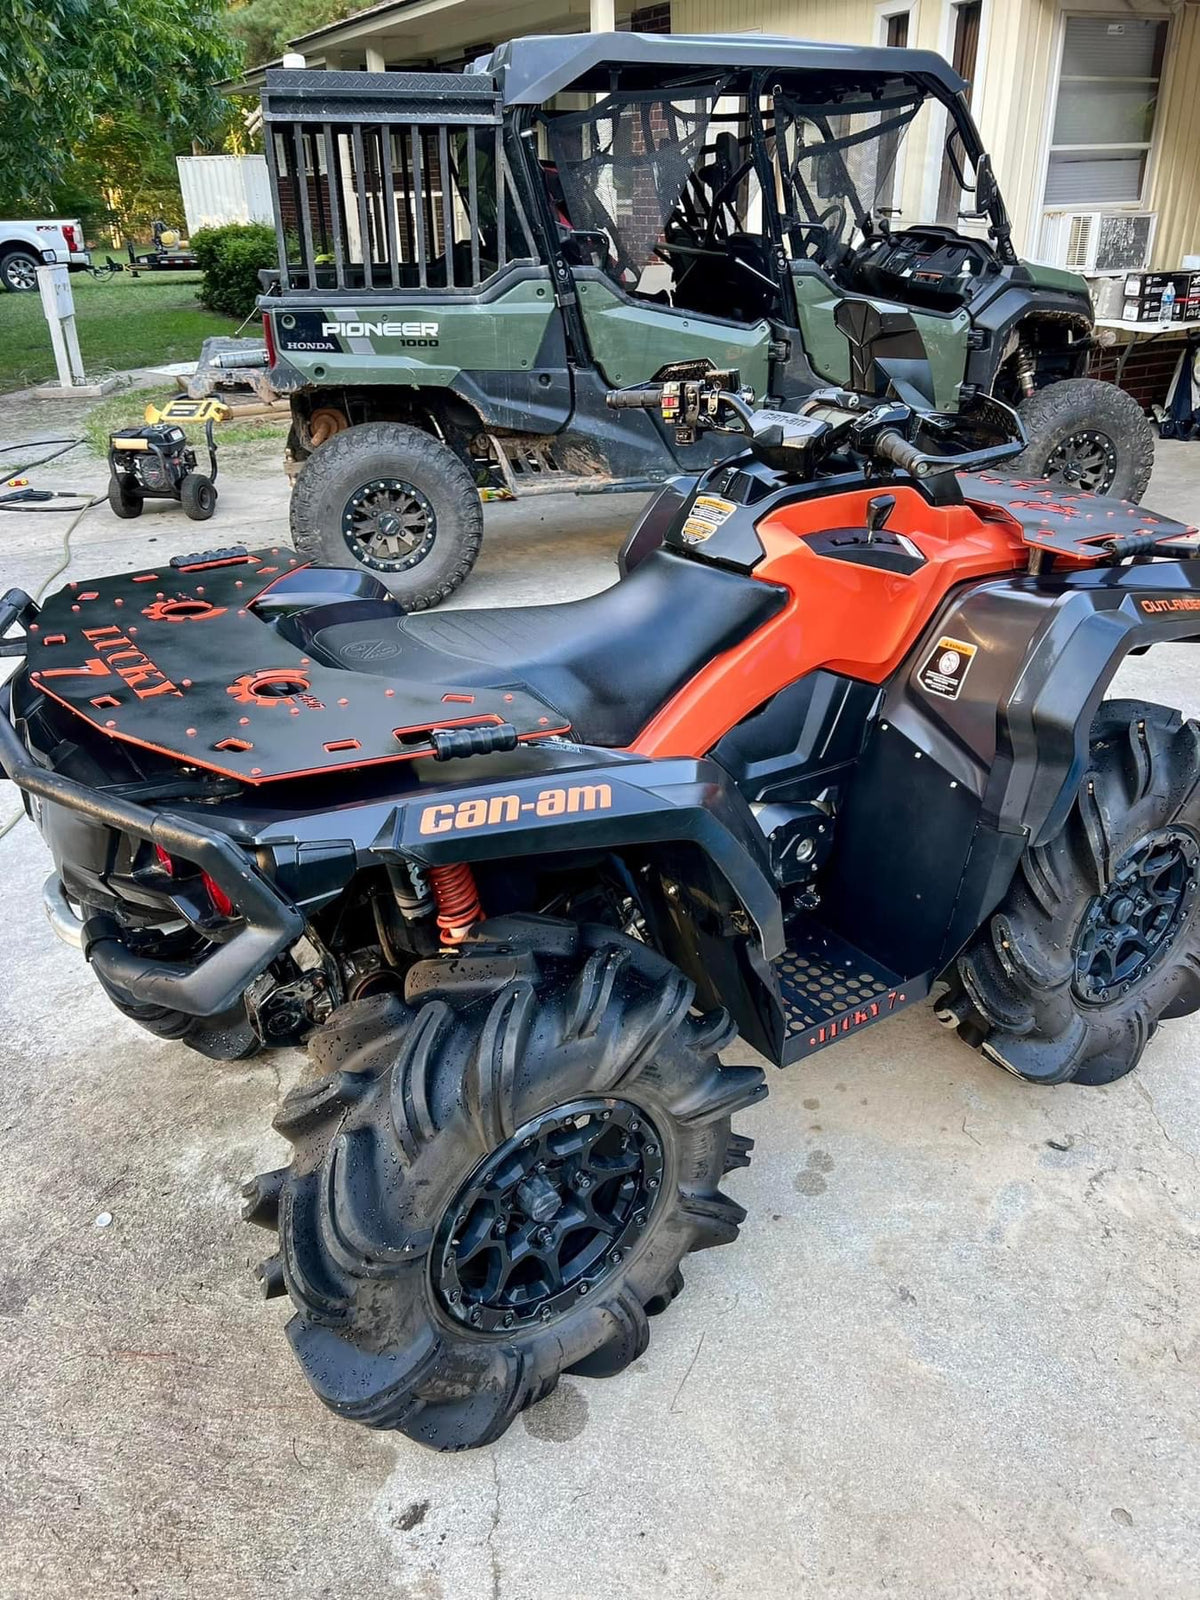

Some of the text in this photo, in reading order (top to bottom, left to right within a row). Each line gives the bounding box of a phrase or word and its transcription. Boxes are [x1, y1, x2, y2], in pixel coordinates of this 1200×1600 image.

[322, 322, 439, 338] PIONEER
[287, 341, 336, 350] HONDA
[400, 339, 439, 347] 1000
[41, 658, 112, 677] 7
[81, 625, 184, 700] LUCKY
[418, 783, 613, 836] can-am
[888, 991, 898, 1010] 7
